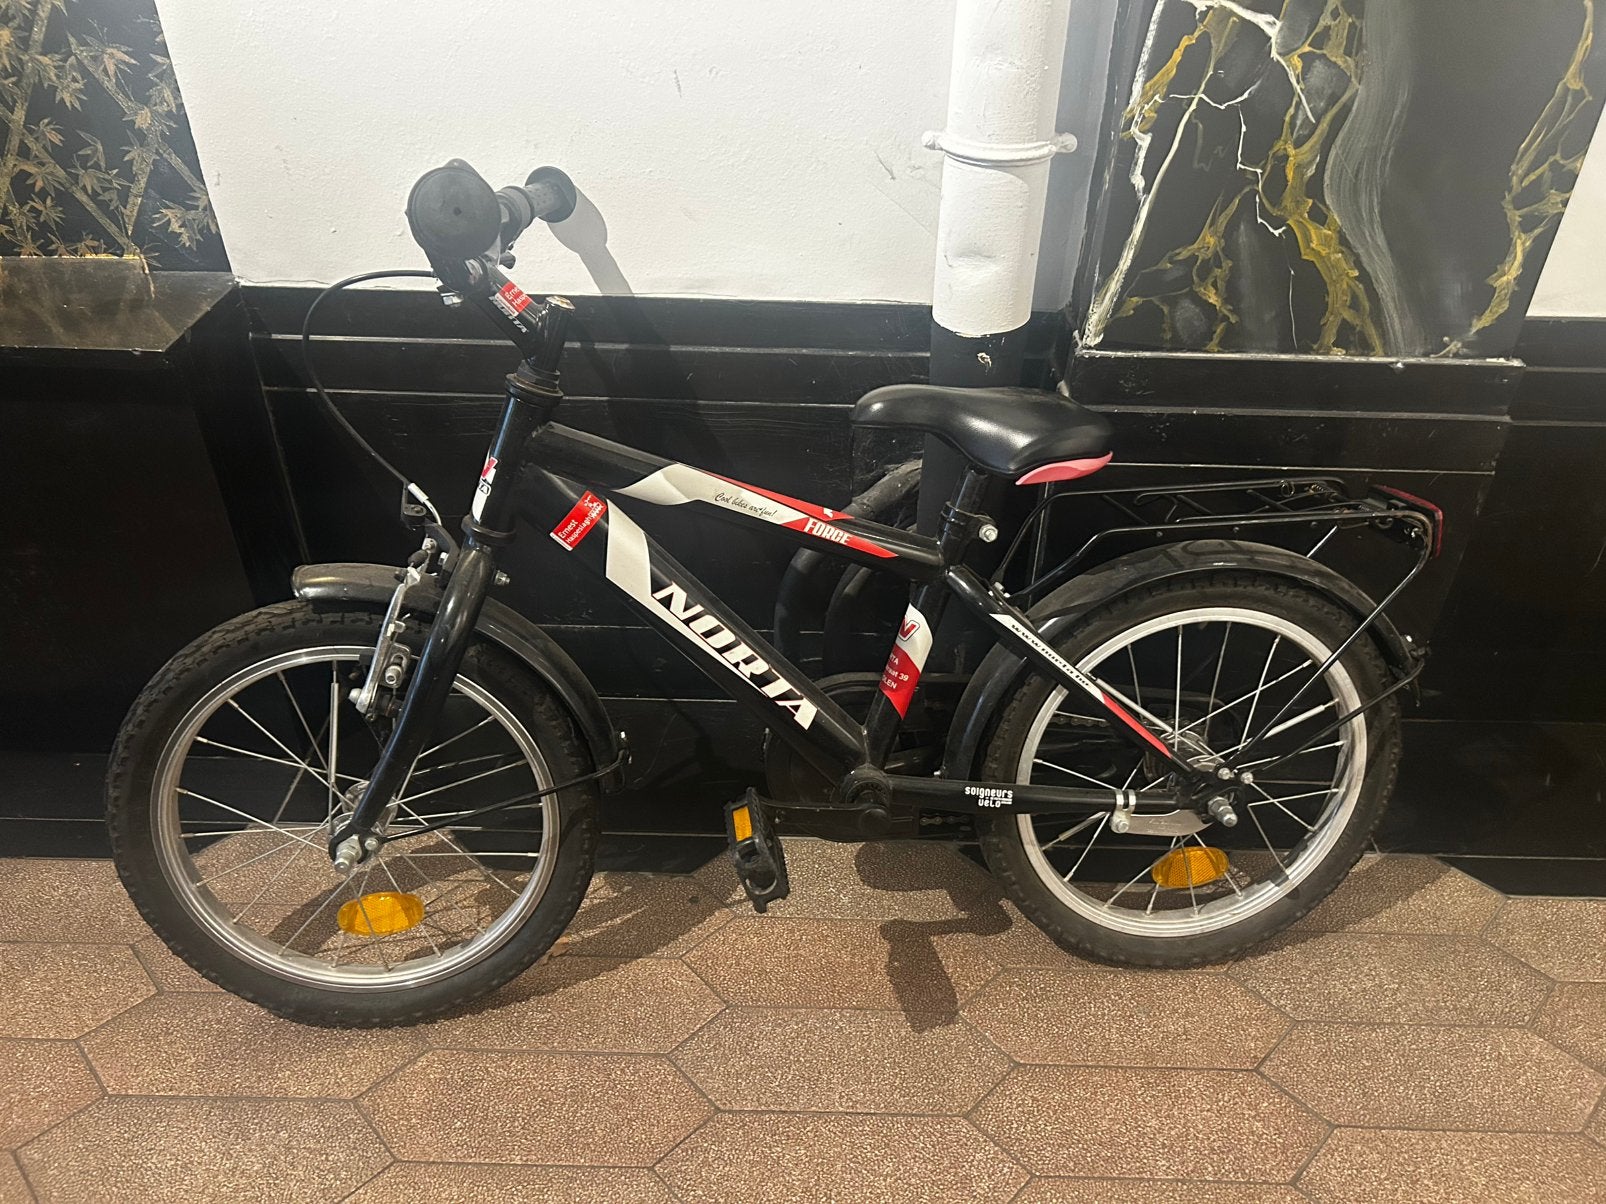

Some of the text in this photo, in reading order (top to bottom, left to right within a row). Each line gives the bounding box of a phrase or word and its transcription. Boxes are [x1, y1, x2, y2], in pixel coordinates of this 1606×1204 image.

[558, 519, 578, 538] Ernest
[803, 517, 853, 545] FORCE
[652, 581, 818, 730] NORTA
[898, 672, 909, 682] 39
